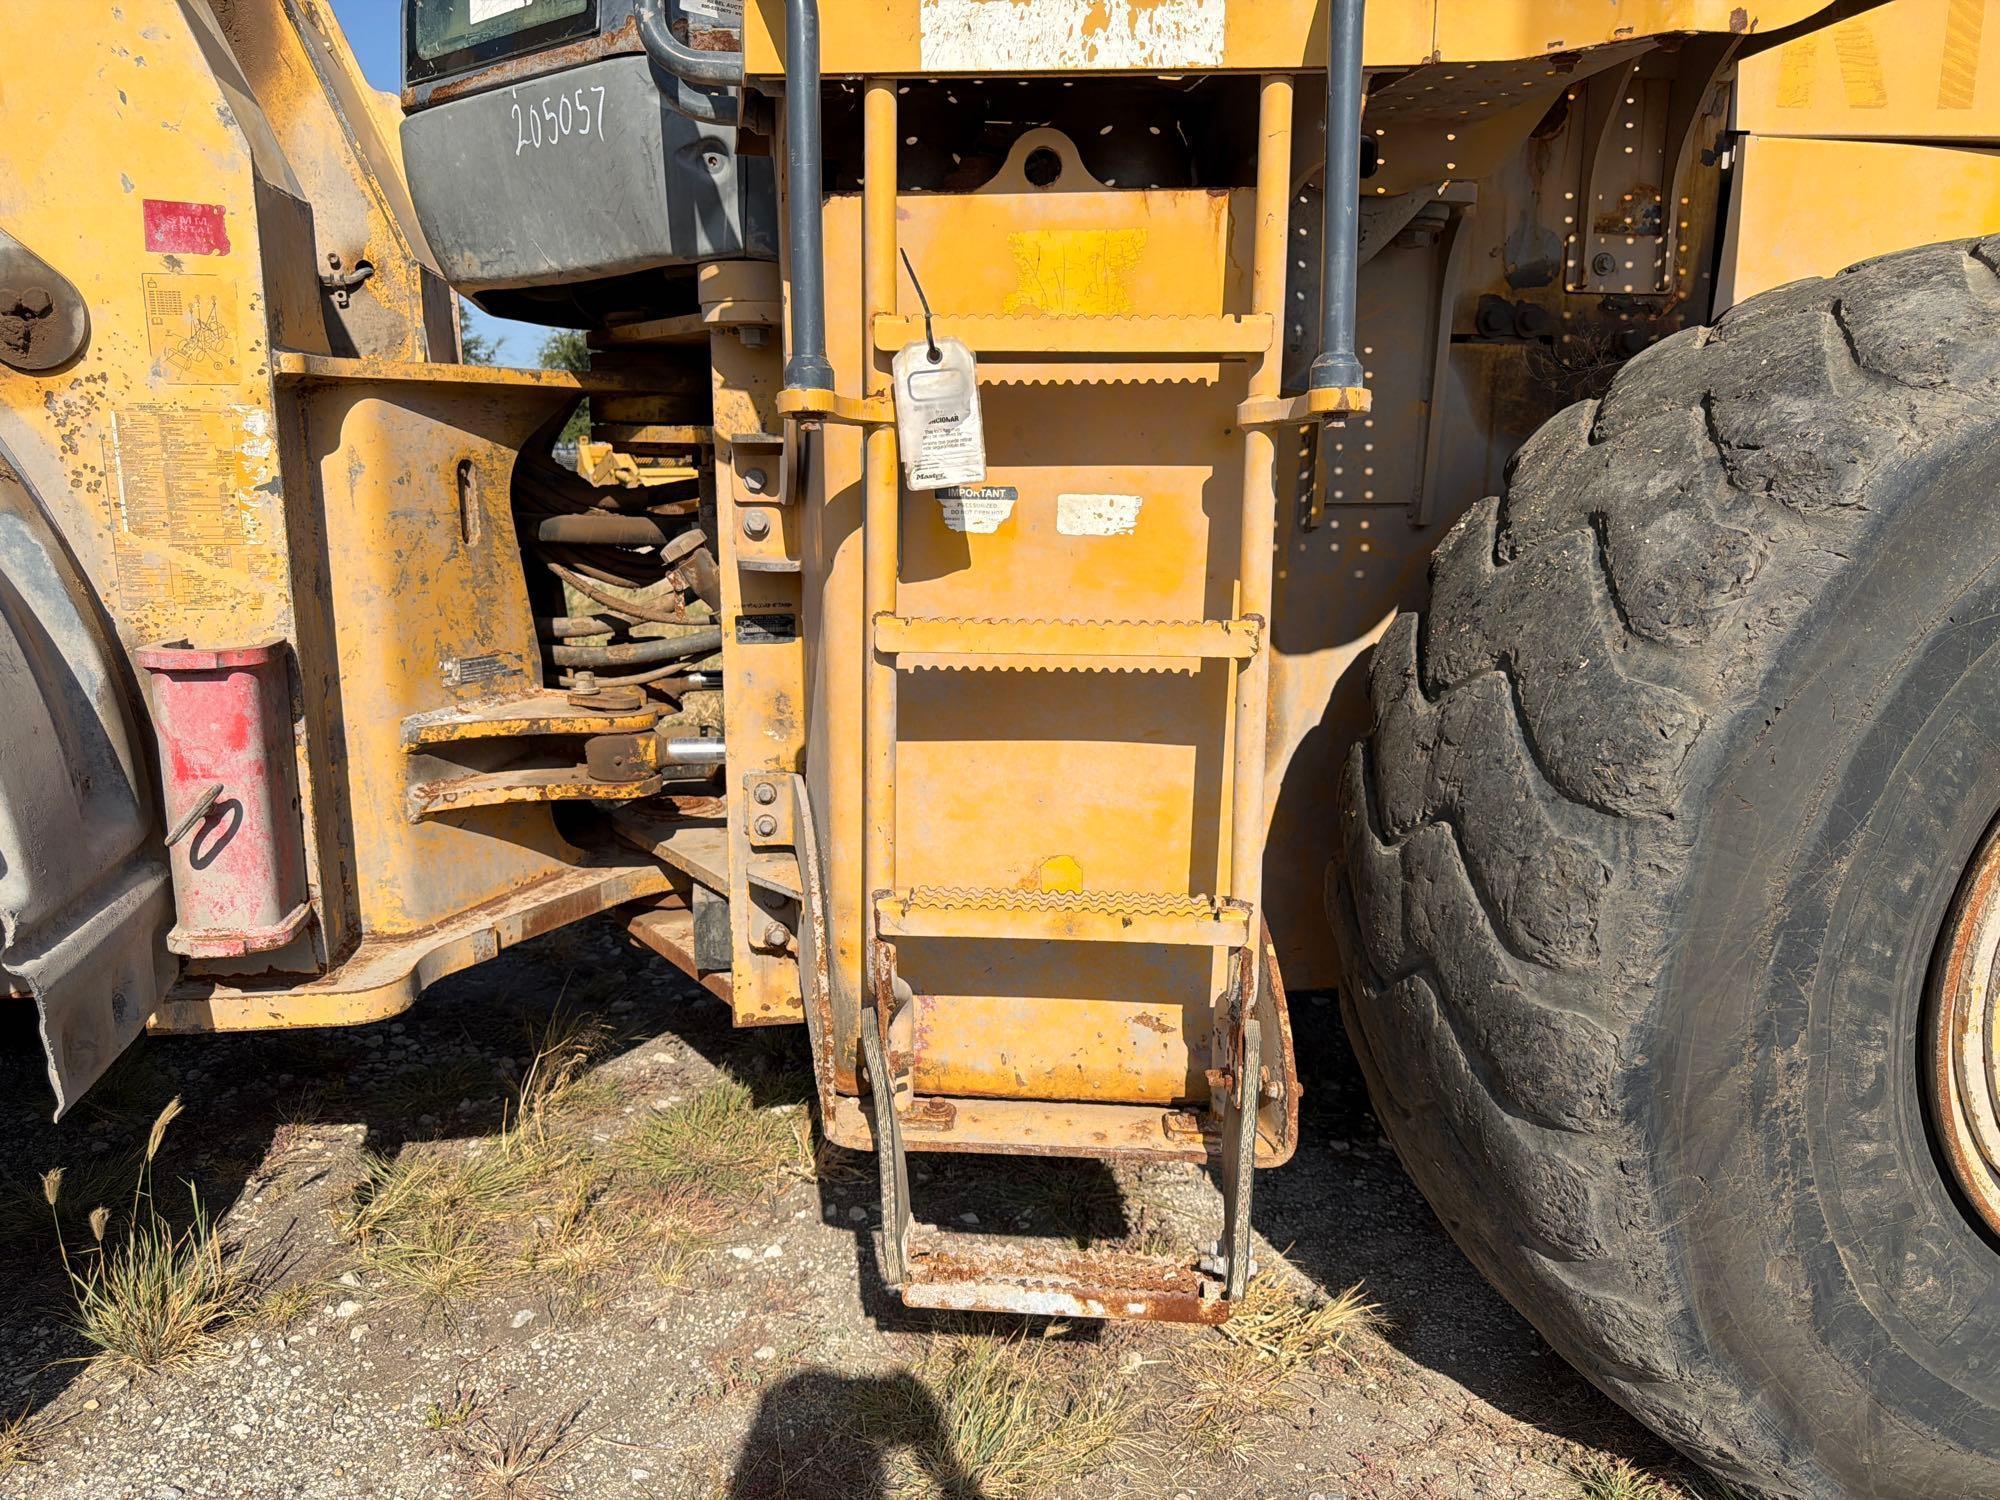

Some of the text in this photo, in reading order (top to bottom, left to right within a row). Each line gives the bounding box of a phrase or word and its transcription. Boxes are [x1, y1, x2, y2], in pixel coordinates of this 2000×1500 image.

[511, 86, 605, 156] 205057
[928, 415, 960, 425] NCIONAR
[948, 488, 1006, 498] IMPORTANT
